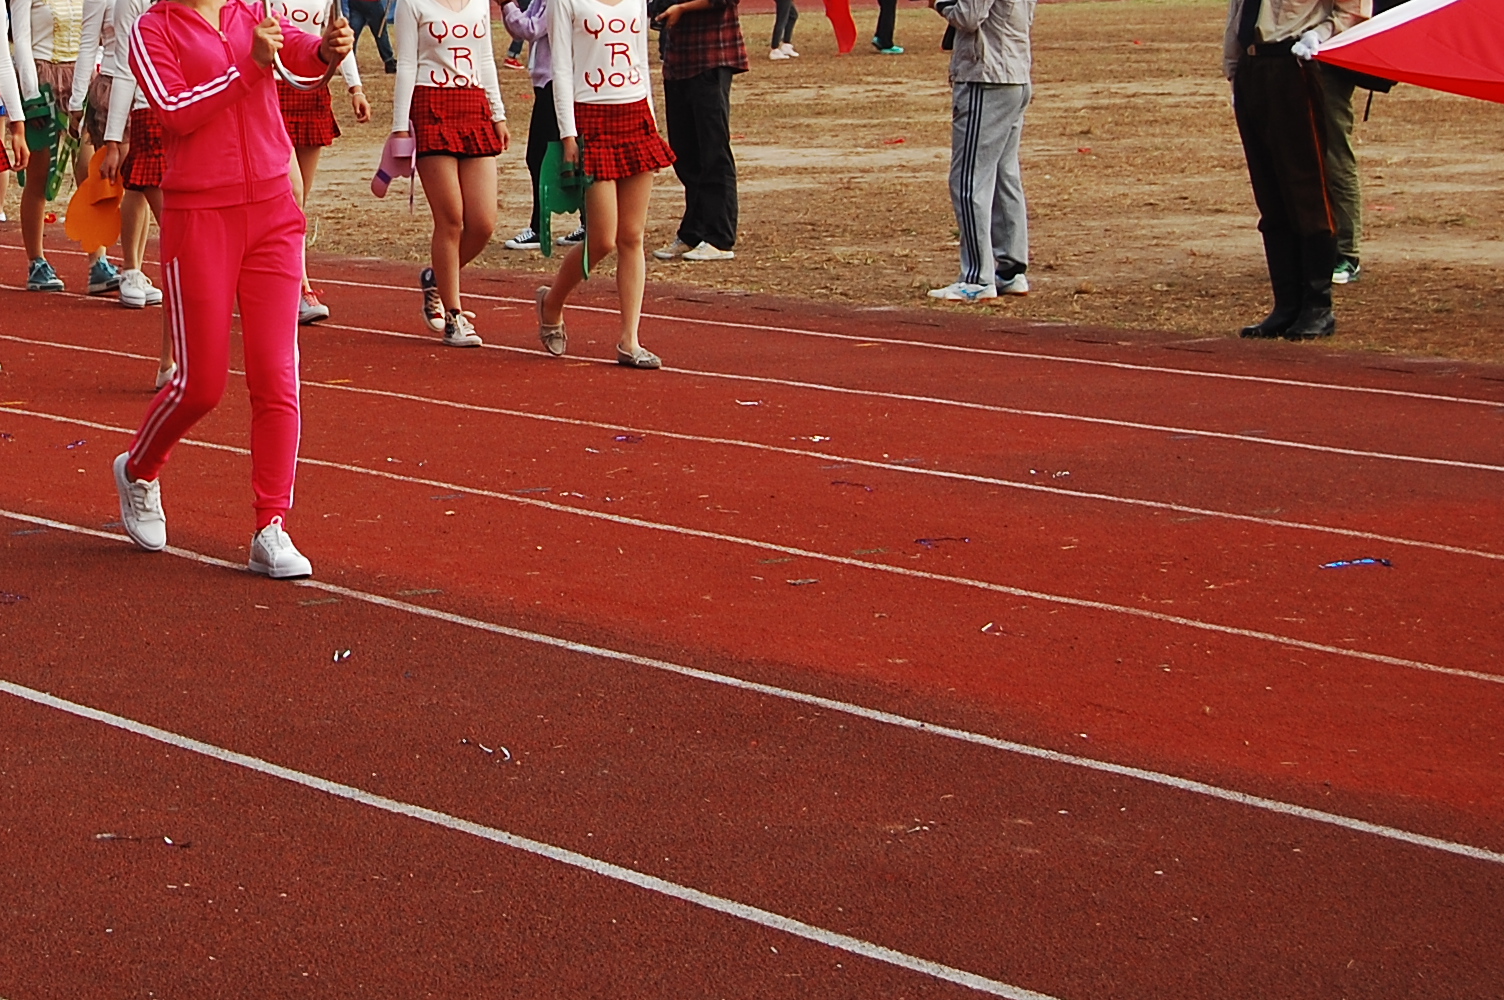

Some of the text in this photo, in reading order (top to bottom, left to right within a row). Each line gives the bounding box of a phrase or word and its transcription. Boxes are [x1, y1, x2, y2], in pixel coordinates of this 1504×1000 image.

[428, 20, 487, 44] YOU
[447, 47, 473, 70] R
[604, 43, 632, 67] R
[584, 68, 643, 93] YOU
